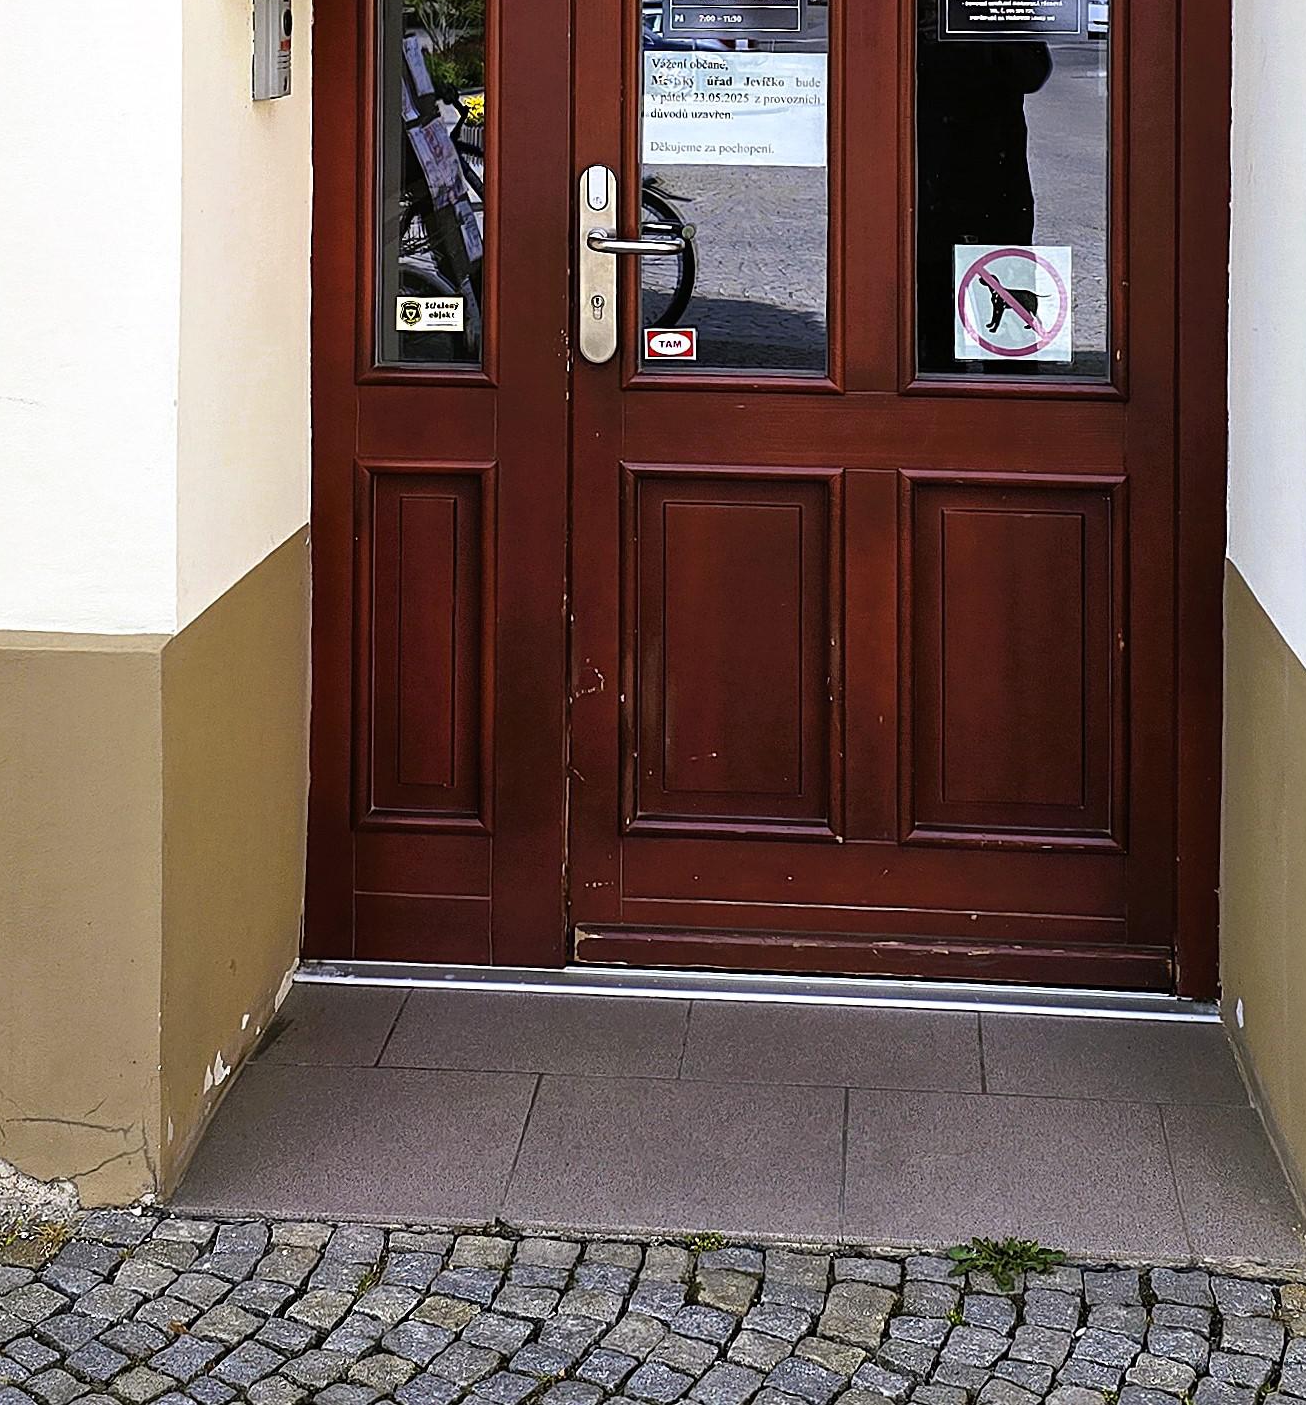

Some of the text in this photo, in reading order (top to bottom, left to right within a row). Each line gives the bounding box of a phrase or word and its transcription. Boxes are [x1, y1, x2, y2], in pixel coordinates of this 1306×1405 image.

[651, 58, 729, 71] Vážení občané,
[707, 75, 733, 86] úřad
[744, 76, 785, 87] Jevíčko
[796, 77, 821, 88] bude
[660, 93, 687, 104] pátek
[693, 93, 749, 103] 23.05.2025
[763, 94, 820, 106] provozních
[650, 108, 688, 119] důvodů
[650, 141, 702, 153] Děkujeme
[718, 143, 774, 155] pochopení.
[658, 340, 682, 348] TAM
